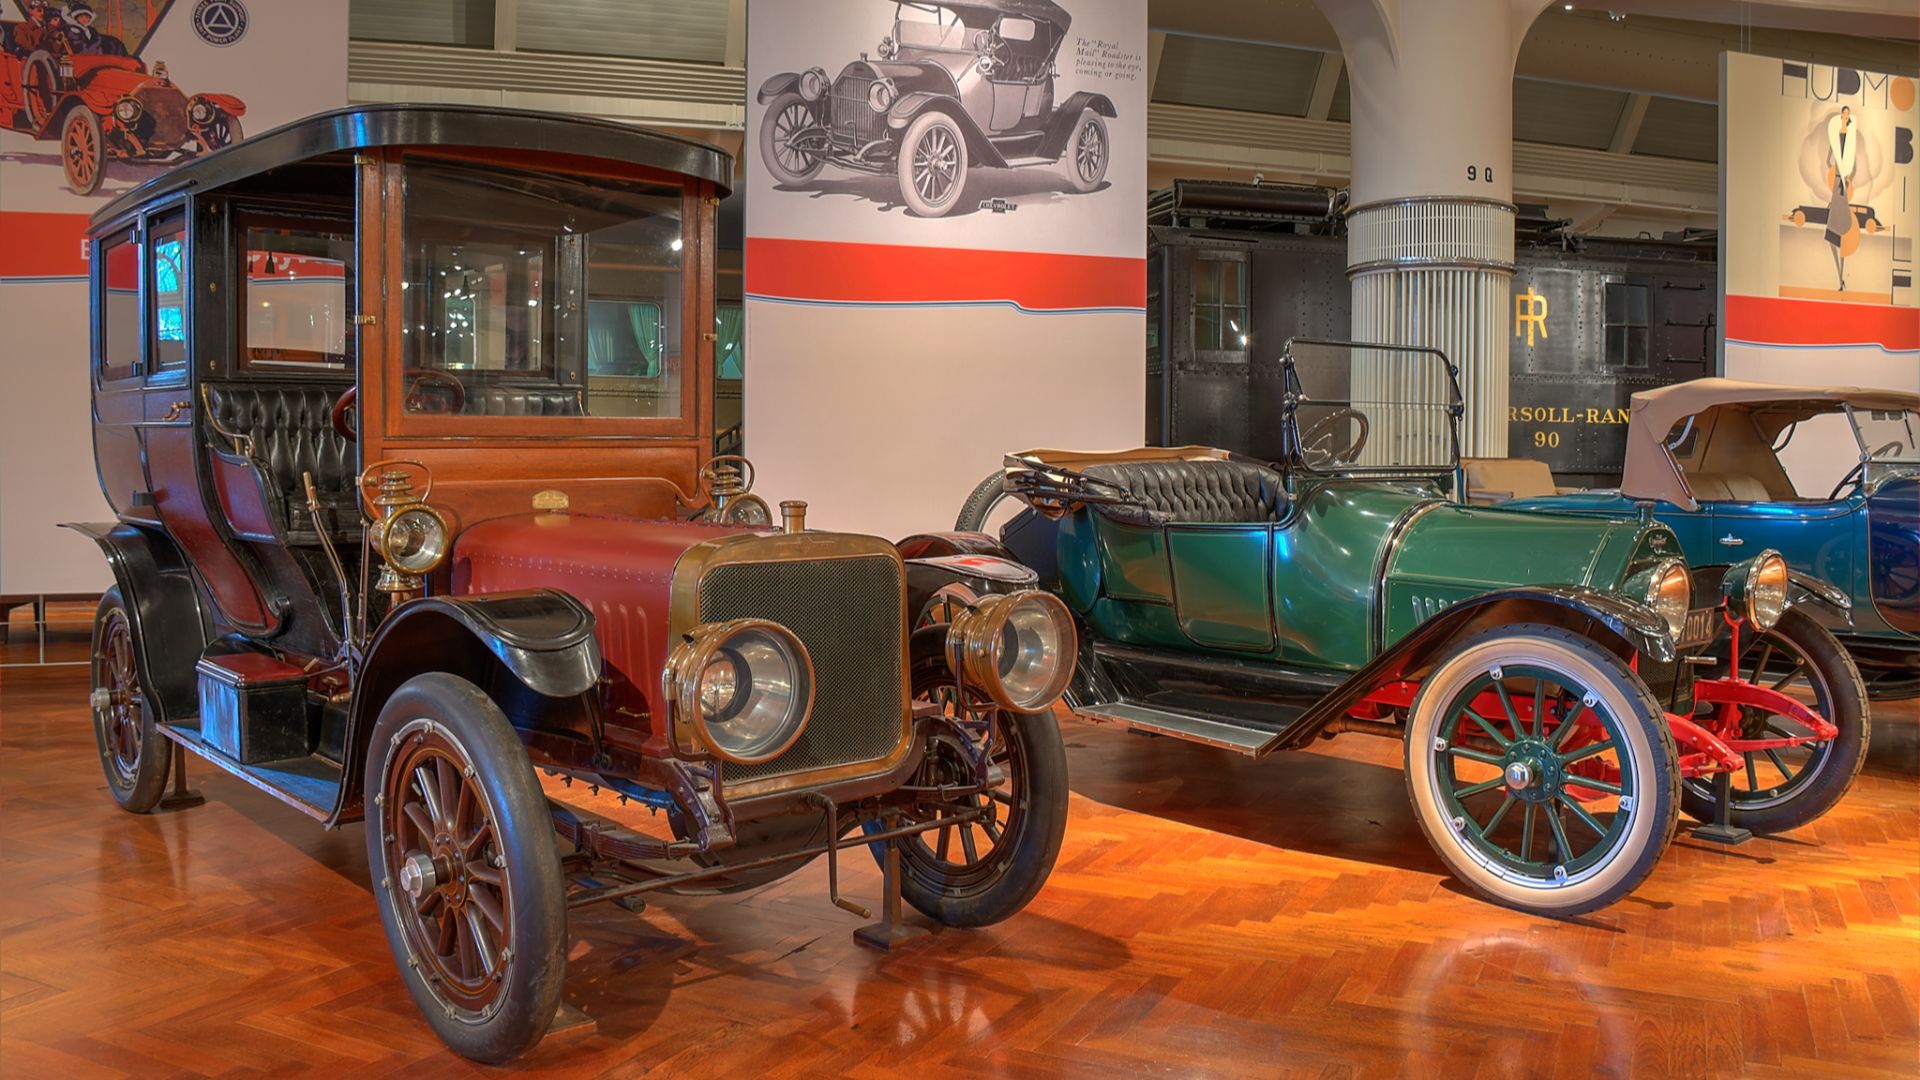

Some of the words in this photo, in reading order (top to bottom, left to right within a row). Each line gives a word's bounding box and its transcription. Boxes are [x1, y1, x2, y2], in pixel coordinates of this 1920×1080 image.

[1077, 37, 1090, 46] The
[1101, 50, 1133, 60] Roadster
[1075, 58, 1107, 69] pleasing
[1075, 69, 1102, 78] coming
[1467, 165, 1477, 181] 9
[1534, 431, 1560, 448] 90
